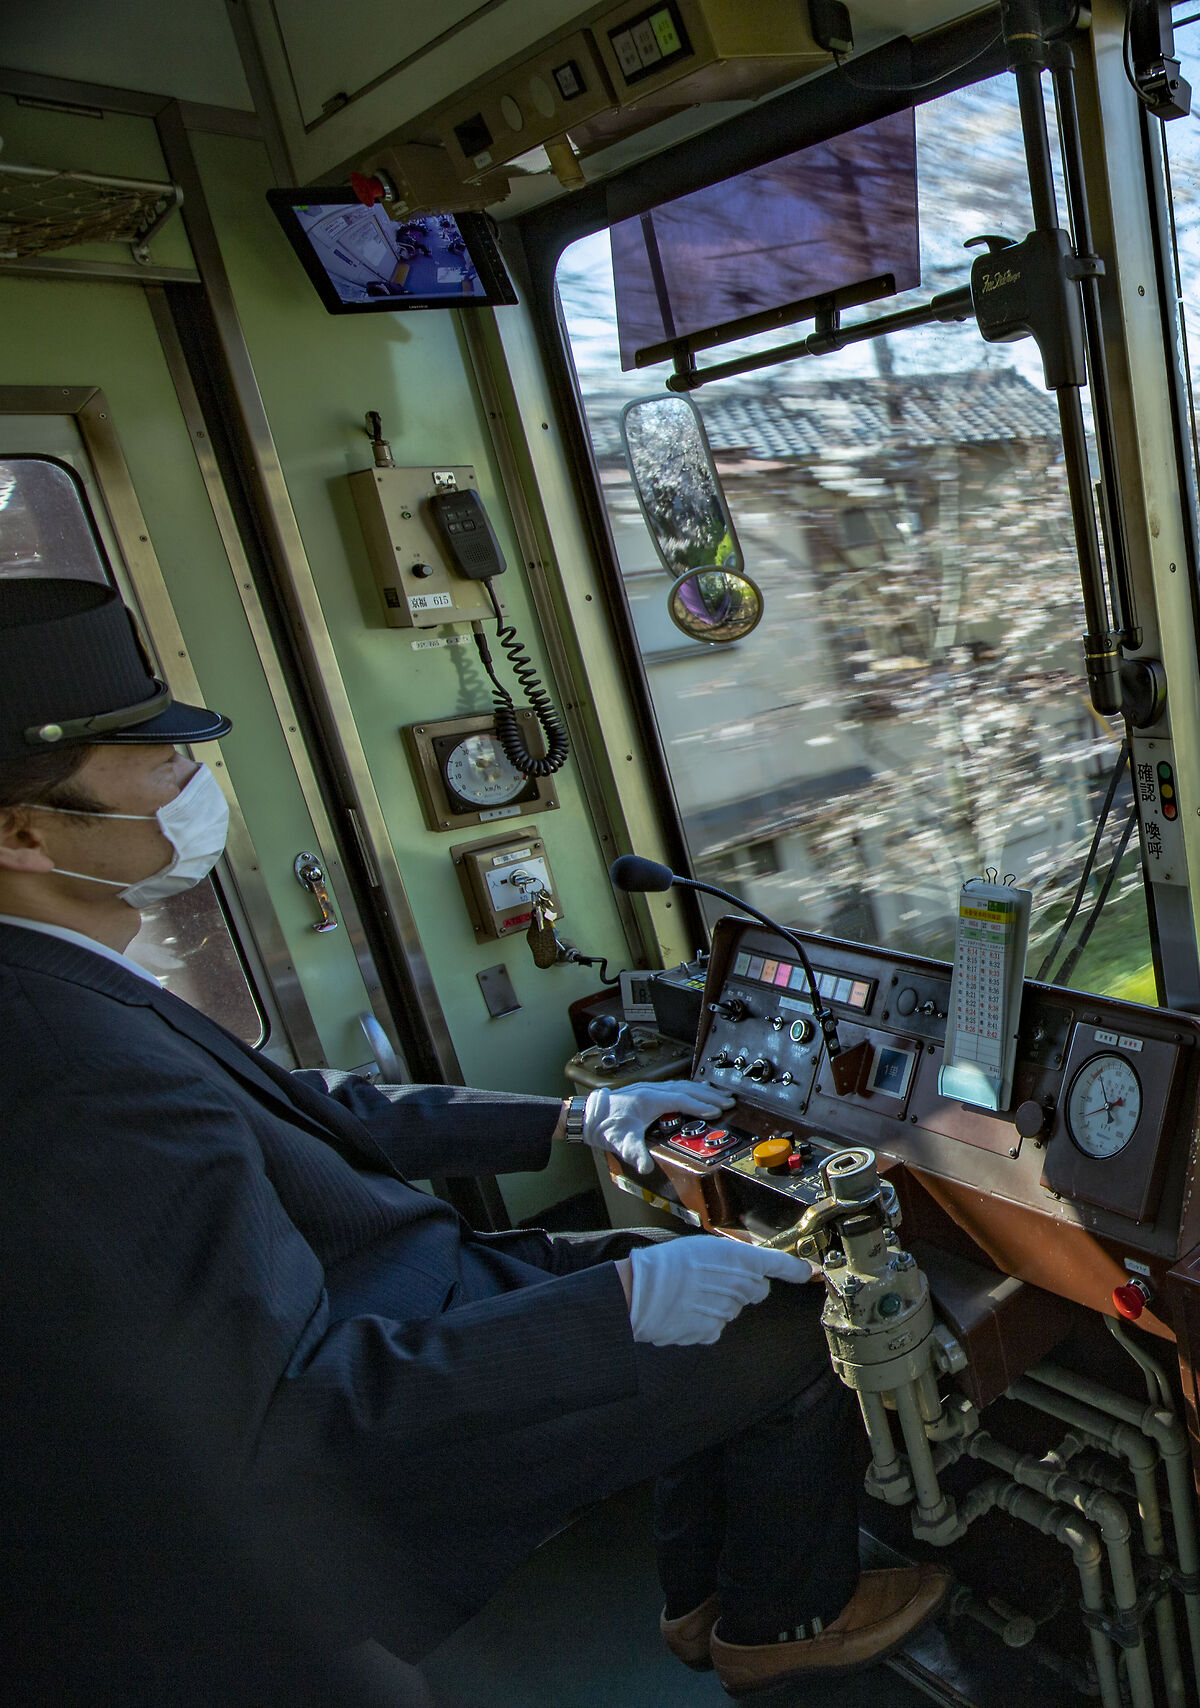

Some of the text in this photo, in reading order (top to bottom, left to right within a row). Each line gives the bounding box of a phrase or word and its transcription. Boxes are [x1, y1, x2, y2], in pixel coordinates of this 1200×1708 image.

[412, 596, 449, 608] 京福 615
[484, 785, 501, 793] km/h
